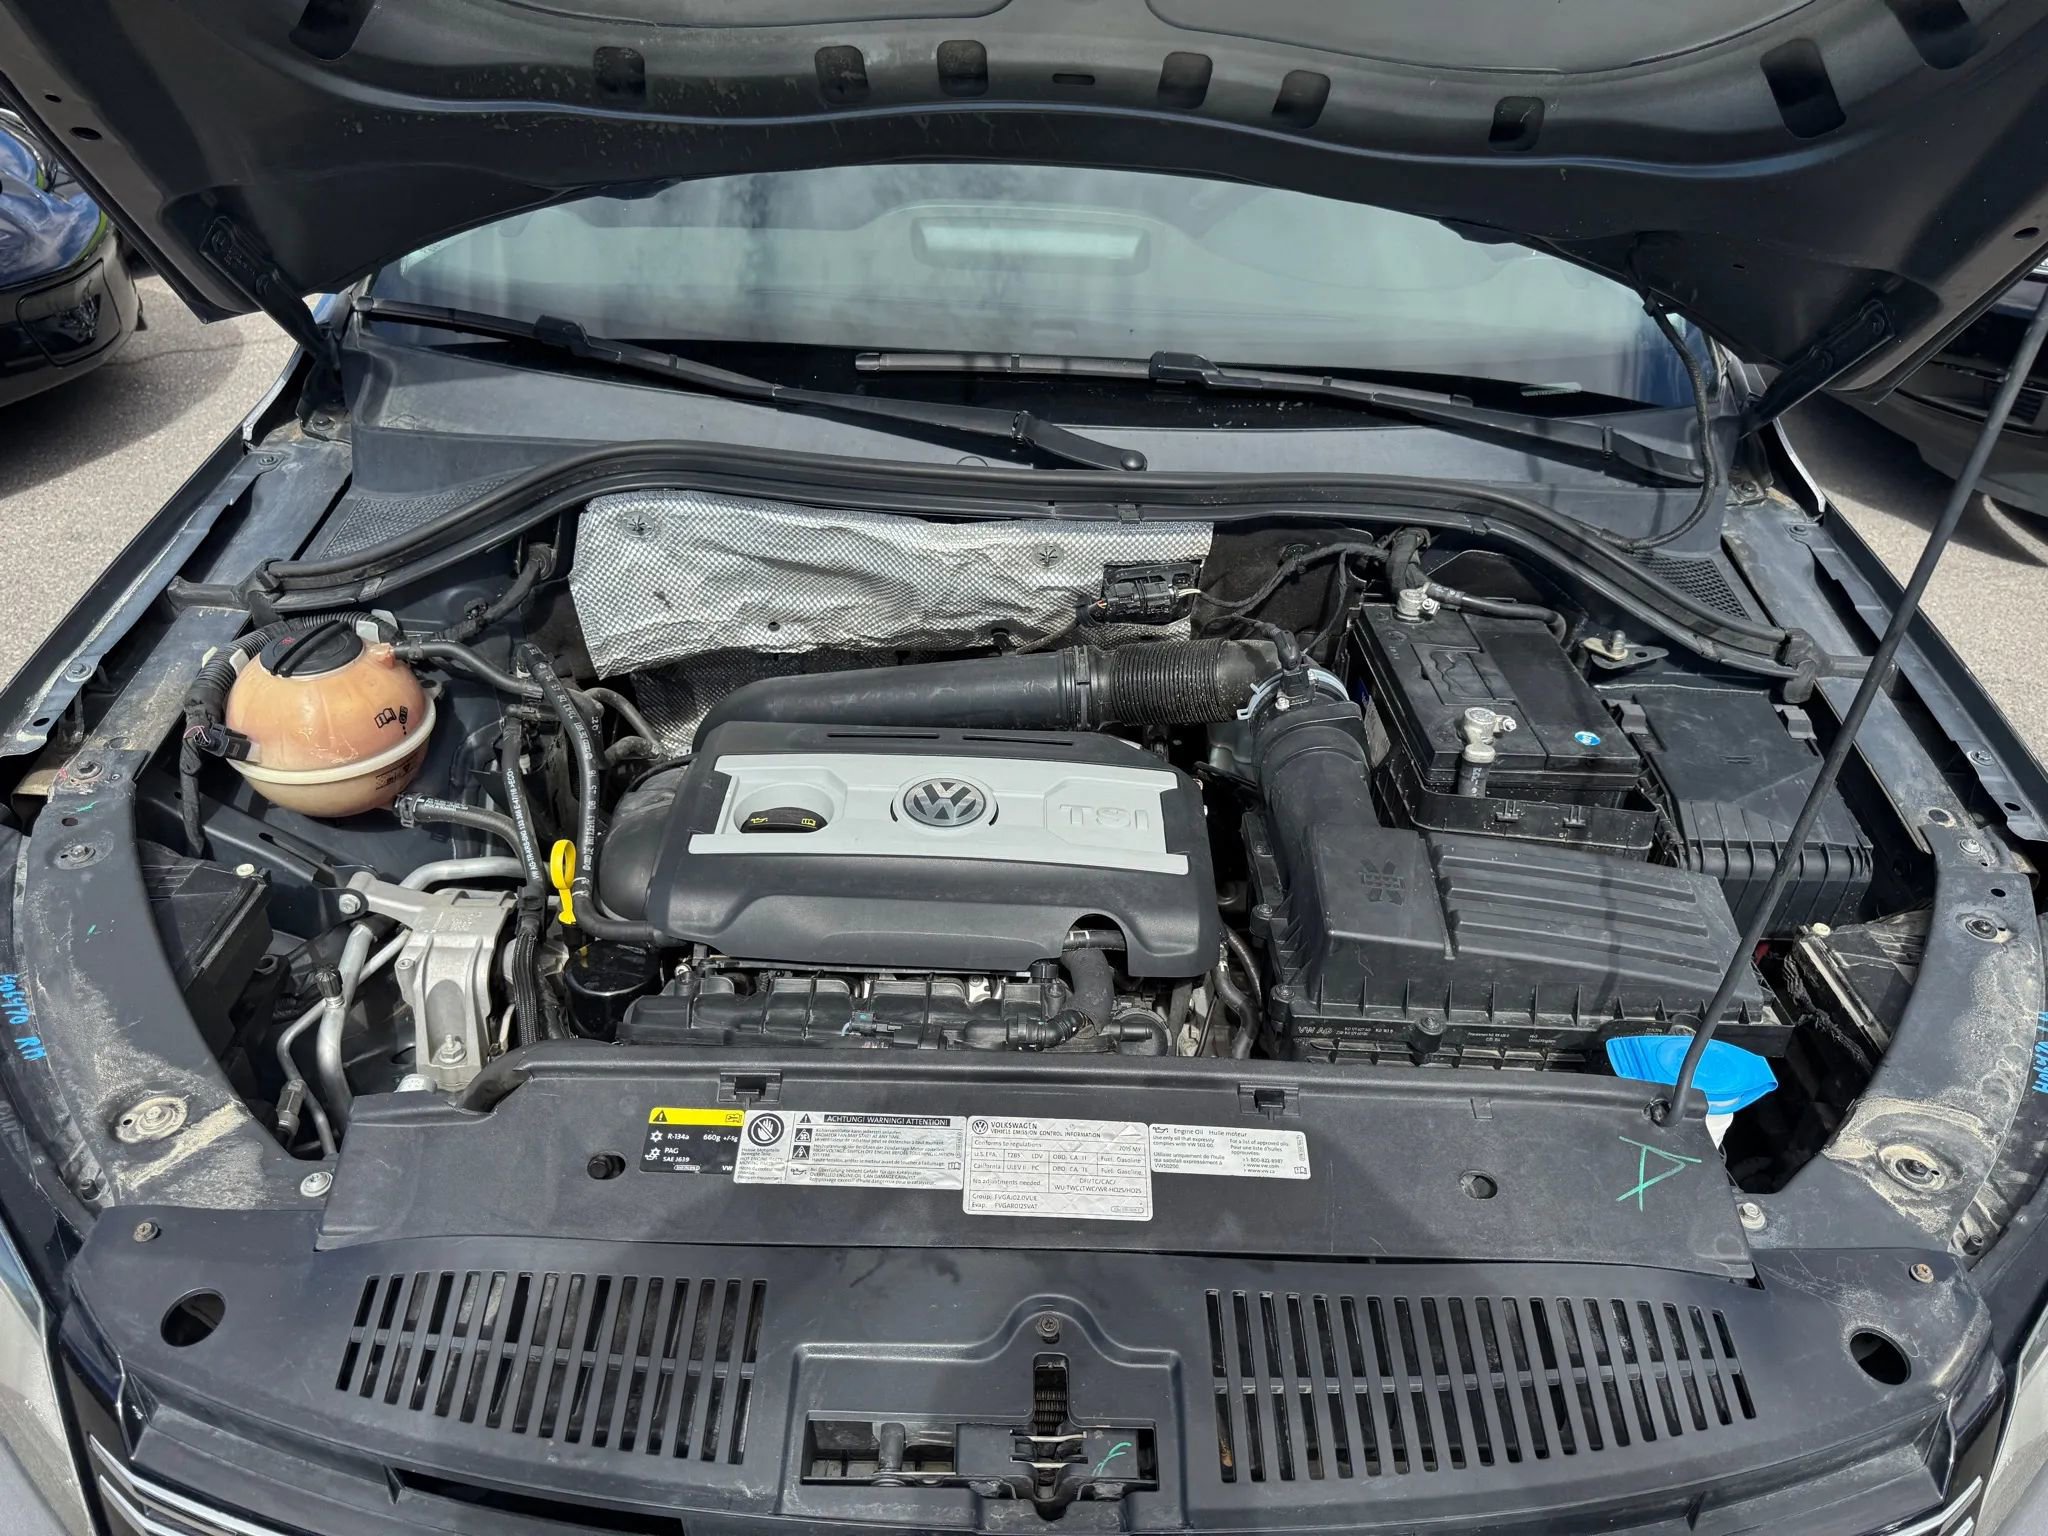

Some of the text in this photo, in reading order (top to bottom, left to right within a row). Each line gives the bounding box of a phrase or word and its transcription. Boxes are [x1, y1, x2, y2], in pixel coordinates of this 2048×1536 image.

[1060, 804, 1149, 830] TSI
[991, 1122, 1038, 1130] VOLKSWAGEN
[703, 1134, 721, 1142] 660g
